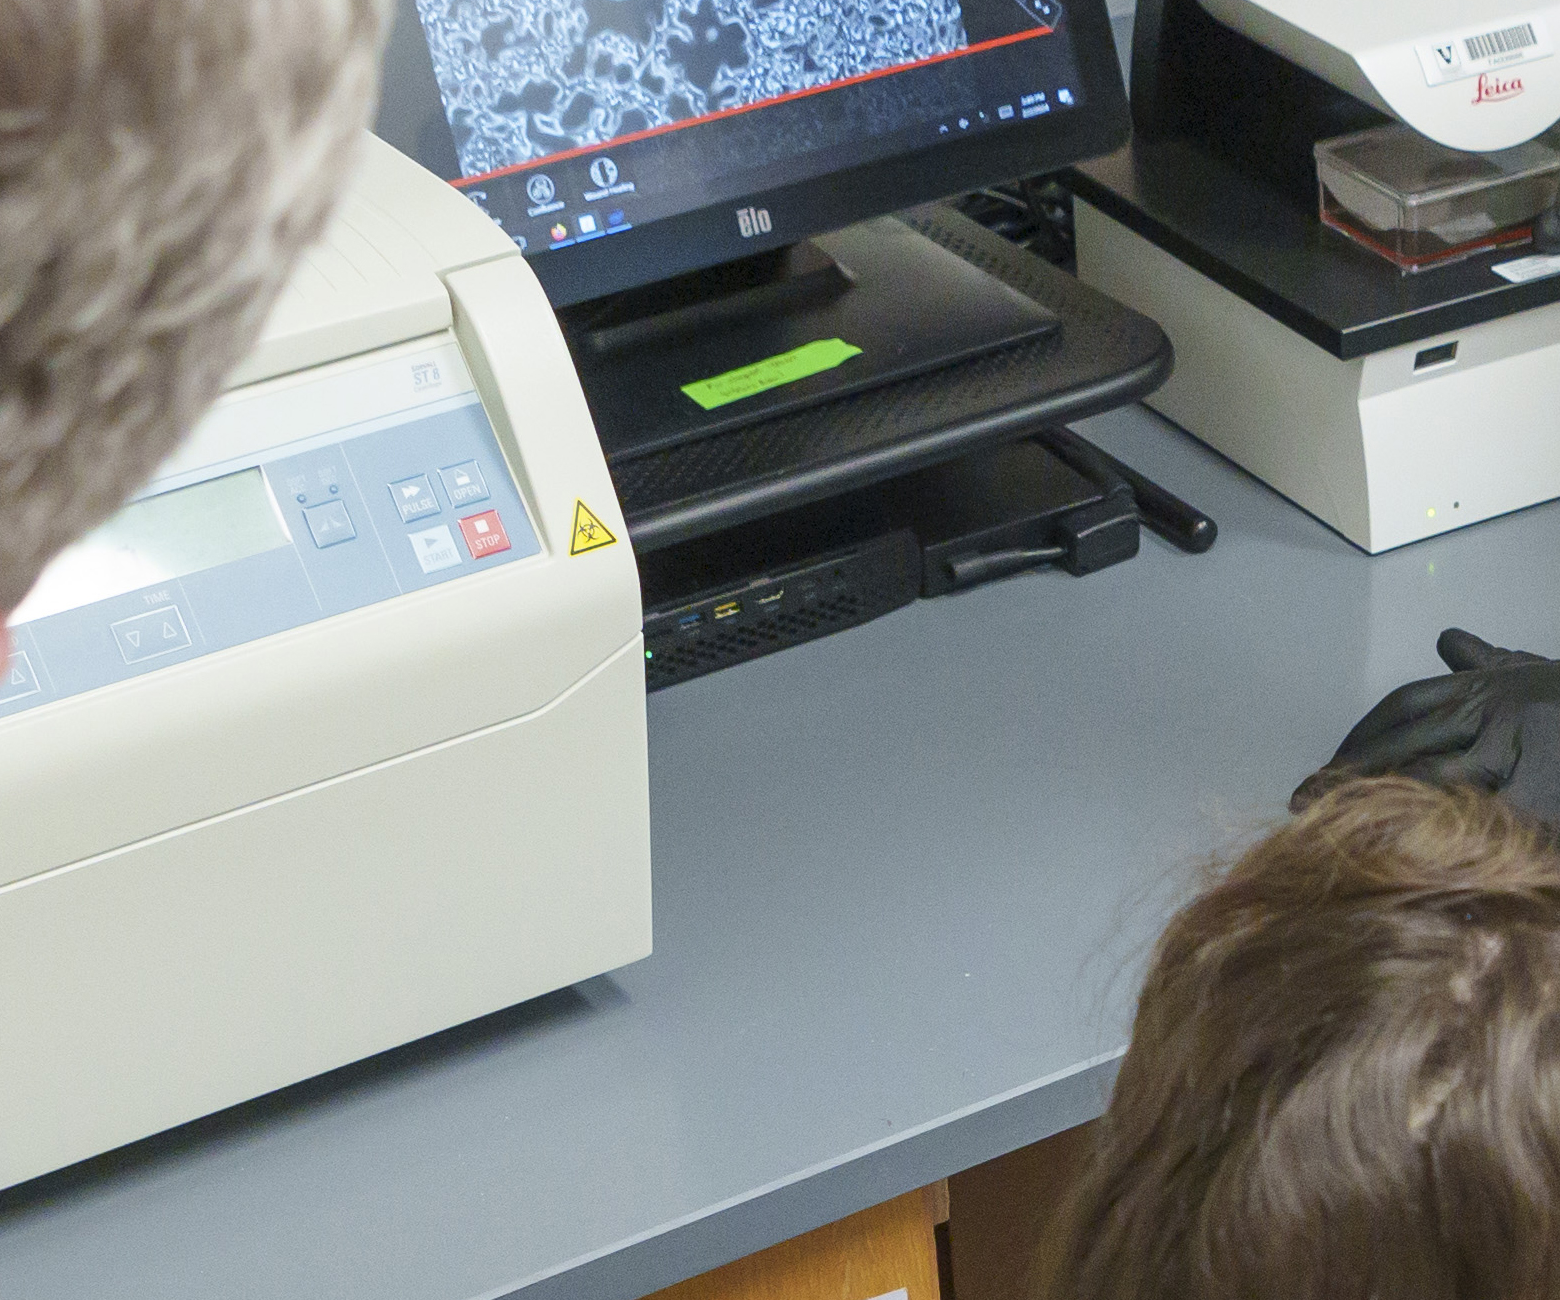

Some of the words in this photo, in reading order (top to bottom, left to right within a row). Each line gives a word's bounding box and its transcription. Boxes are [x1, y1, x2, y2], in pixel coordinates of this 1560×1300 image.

[1471, 72, 1525, 106] Leica
[414, 370, 431, 386] ST
[433, 367, 441, 381] 8
[453, 484, 482, 500] OPEN
[402, 500, 435, 516] PULSE
[475, 534, 500, 551] STOP
[422, 549, 454, 566] START
[143, 589, 170, 606] TIME
